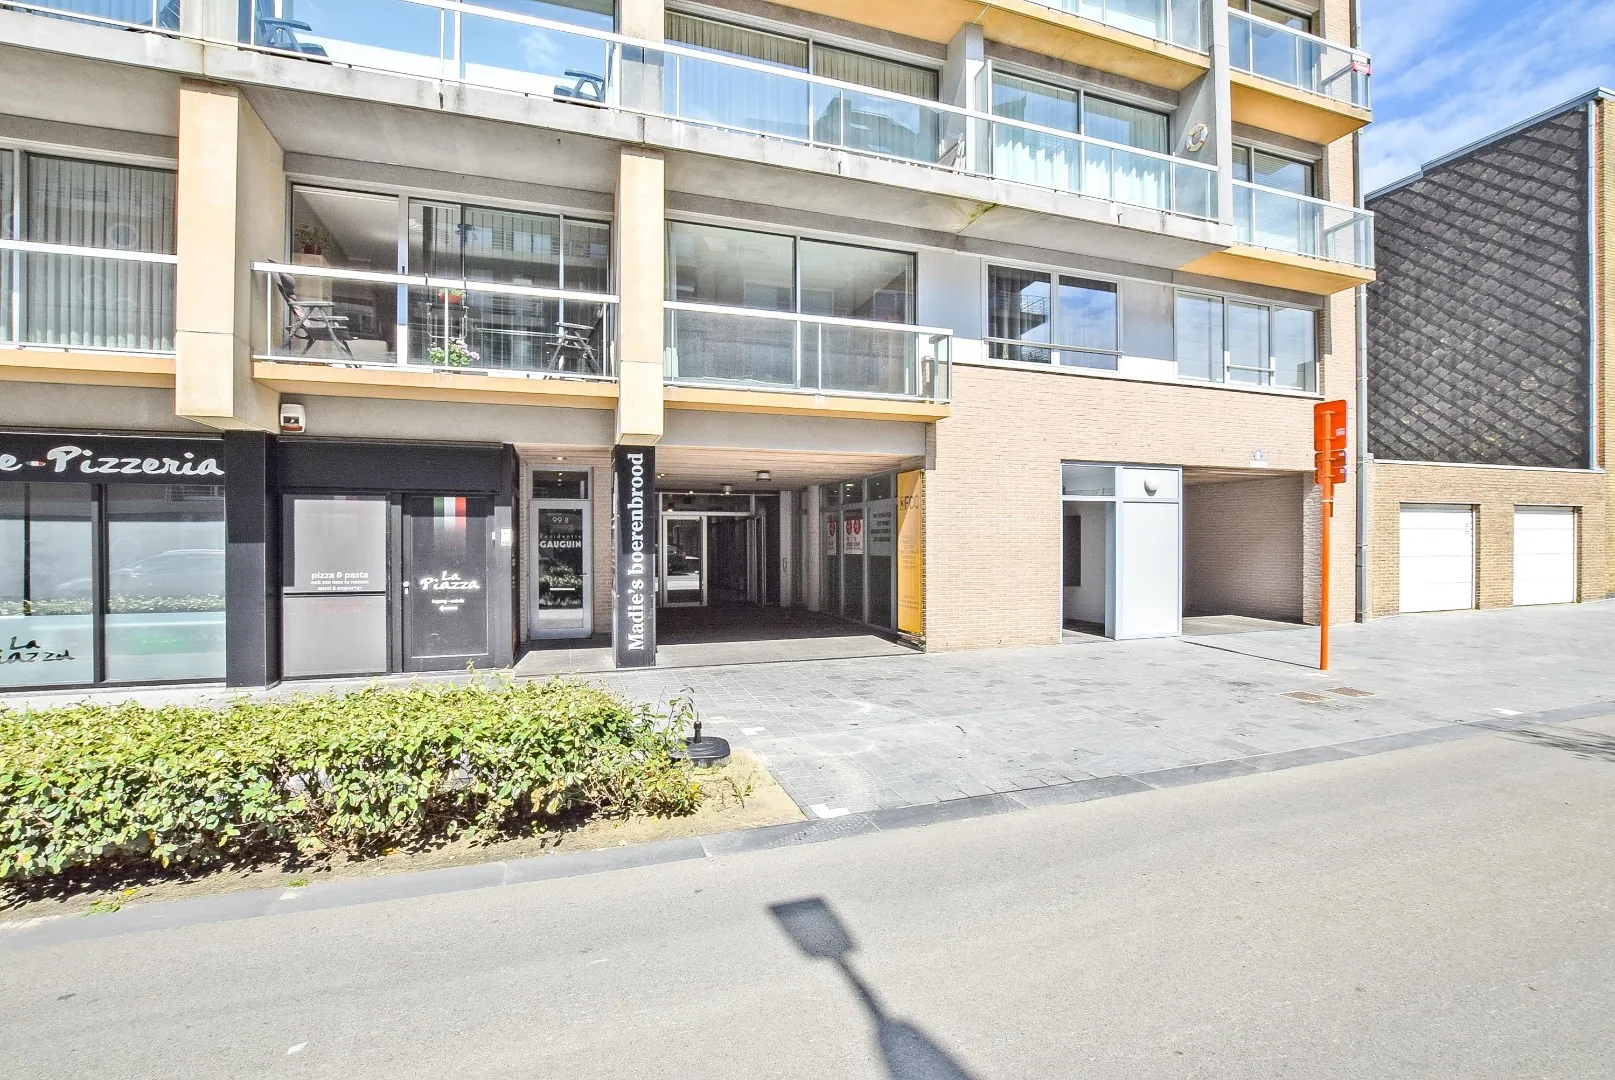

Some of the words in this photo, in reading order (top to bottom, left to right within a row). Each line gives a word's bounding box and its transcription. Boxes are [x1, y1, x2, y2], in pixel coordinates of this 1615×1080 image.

[47, 446, 225, 475] Pizzeria
[552, 516, 562, 524] 99
[627, 453, 644, 576] boerenbrood
[539, 540, 582, 548] GAUGUIN
[311, 571, 335, 580] pizza
[344, 571, 369, 579] pasta
[441, 570, 461, 580] La
[419, 577, 480, 590] Piazza
[627, 579, 644, 651] Madie's
[9, 636, 41, 650] La
